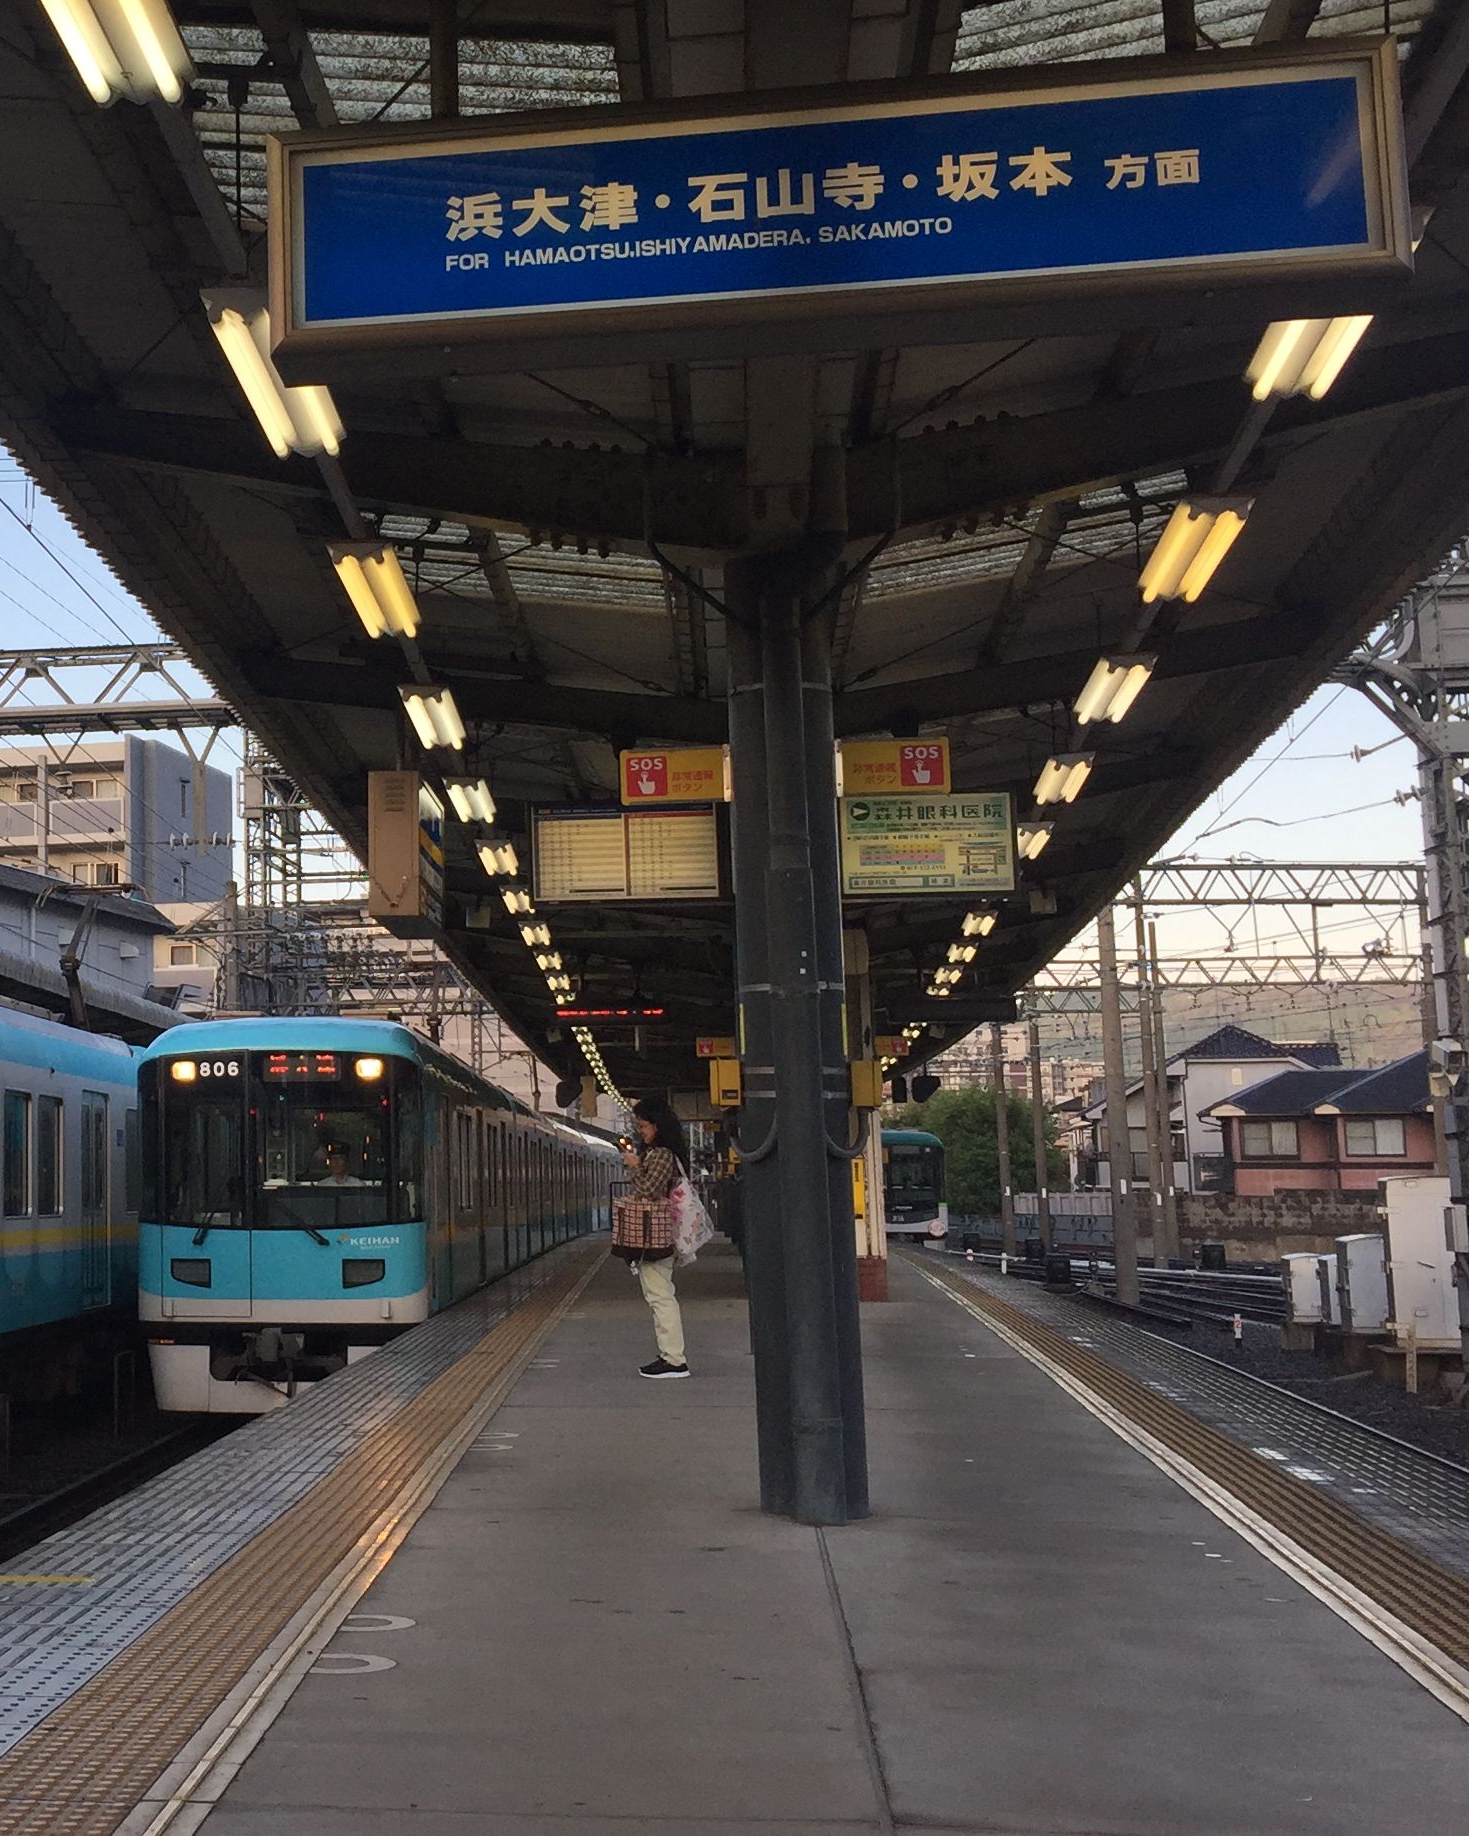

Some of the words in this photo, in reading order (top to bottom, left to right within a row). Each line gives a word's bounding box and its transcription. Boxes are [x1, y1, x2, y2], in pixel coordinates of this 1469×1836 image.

[445, 145, 1073, 243] 浜大津・石山寺・坂本
[1103, 148, 1201, 191] 方面
[445, 252, 490, 272] FOR
[817, 216, 953, 243] SAKAMOTO
[904, 746, 939, 760] SOS
[629, 757, 664, 772] SOS
[873, 803, 1004, 821] 森井眼科医院
[198, 1060, 240, 1078] 806
[350, 1236, 400, 1246] KEIHAN
